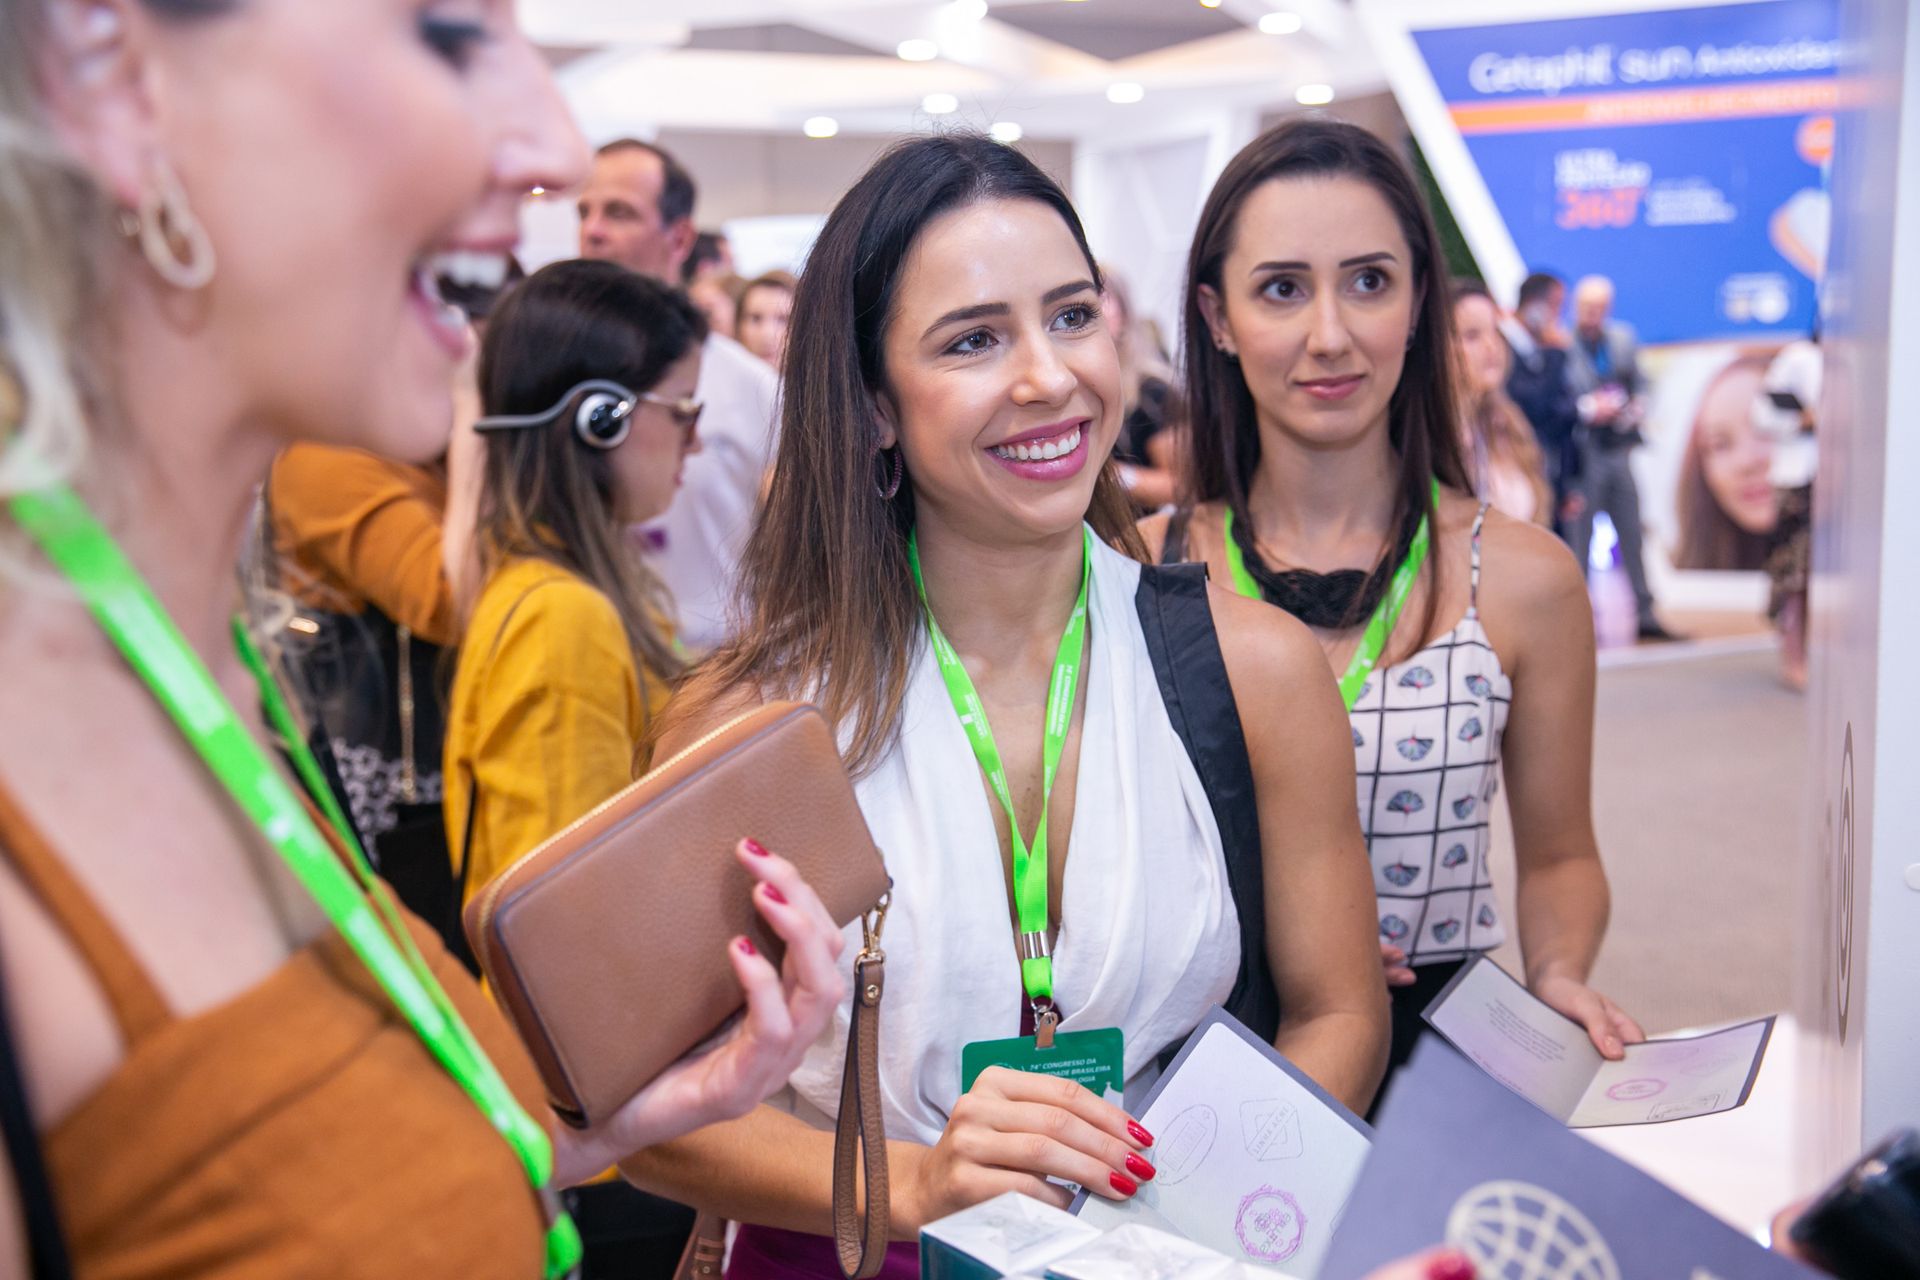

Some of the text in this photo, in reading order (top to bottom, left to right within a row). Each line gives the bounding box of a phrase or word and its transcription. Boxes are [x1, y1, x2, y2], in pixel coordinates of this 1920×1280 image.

[1042, 1059, 1085, 1070] CONGRESSO
[1086, 1057, 1096, 1065] DA
[1071, 1065, 1111, 1075] BRASILEIRA
